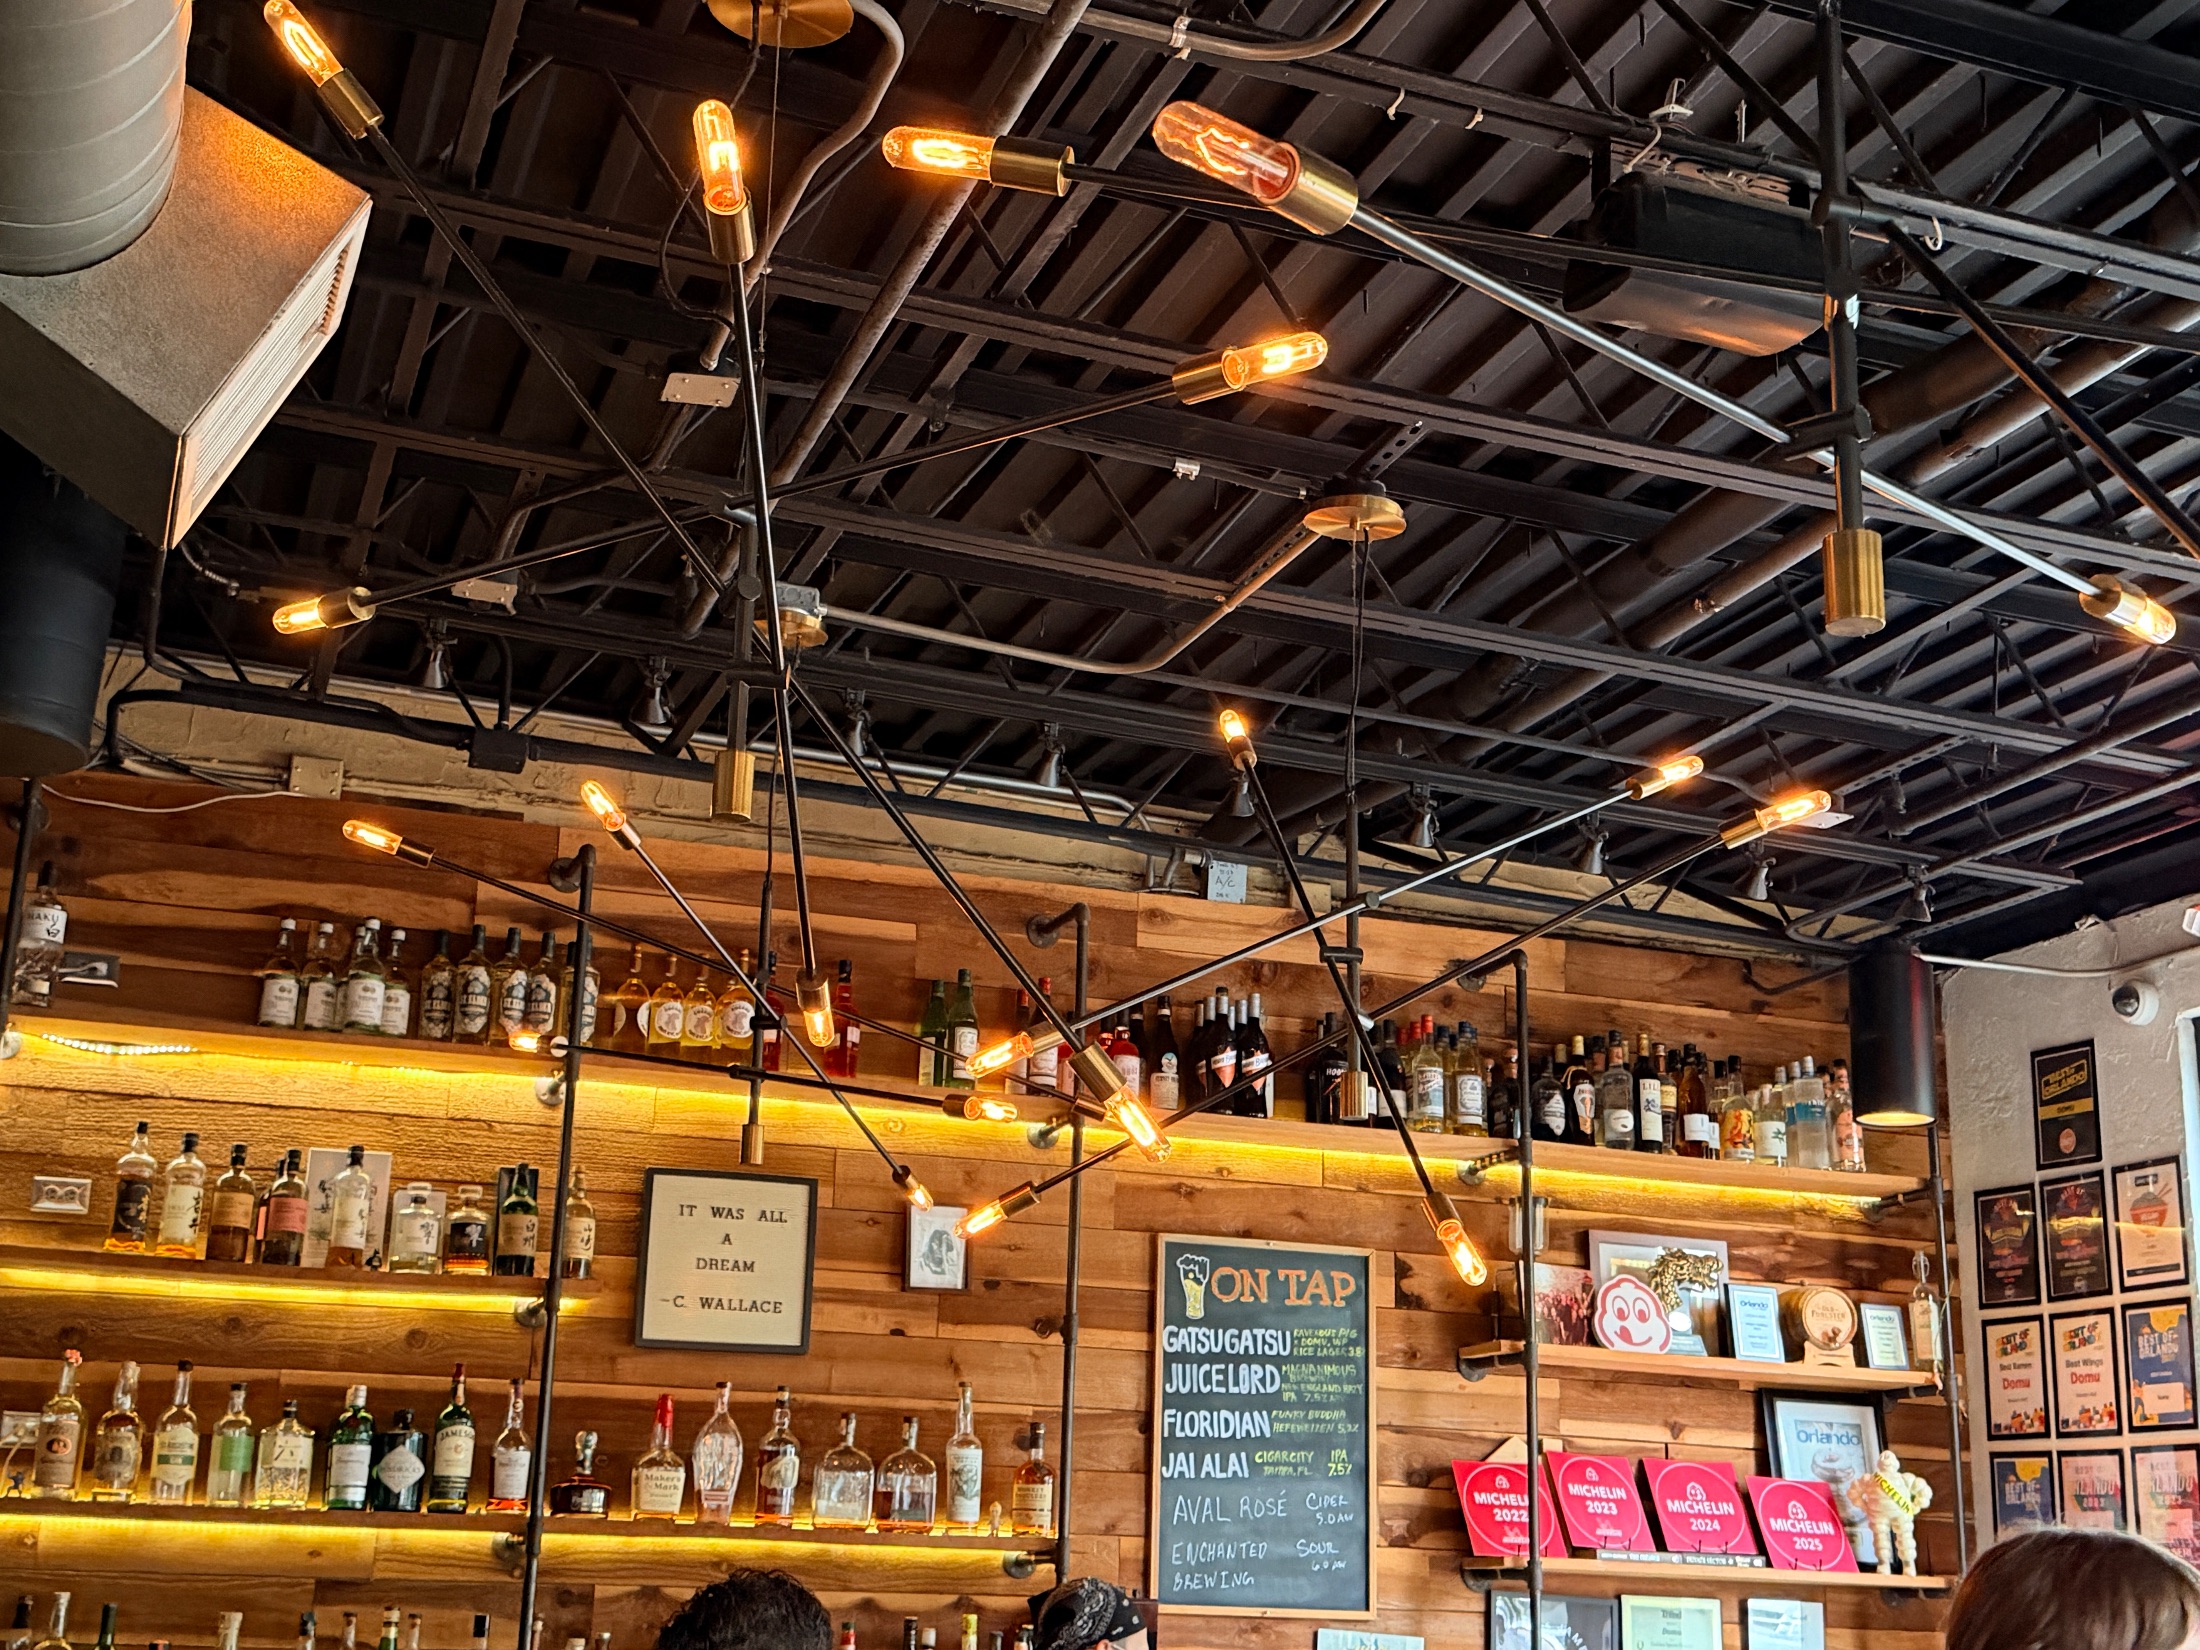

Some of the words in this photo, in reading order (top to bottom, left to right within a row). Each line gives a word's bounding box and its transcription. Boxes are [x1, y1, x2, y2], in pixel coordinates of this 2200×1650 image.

[1215, 875, 1235, 890] A/C
[679, 1204, 697, 1217] IT
[711, 1206, 745, 1220] WAS
[757, 1210, 788, 1223] ALL
[721, 1233, 733, 1246] A
[696, 1257, 756, 1273] DREAM
[1211, 1266, 1271, 1303] ON
[1277, 1269, 1356, 1307] TAP
[699, 1296, 783, 1314] WALLACE
[1338, 1328, 1358, 1338] PIG
[2138, 1333, 2161, 1346] BEST
[1293, 1347, 1315, 1356] RICE
[2066, 1360, 2081, 1368] Best
[2082, 1359, 2104, 1367] Wings
[2002, 1378, 2031, 1390] Domu
[2070, 1372, 2101, 1384] Domu
[1271, 1410, 1305, 1419] FUNKY
[1307, 1410, 1347, 1421] BUDDHA
[1163, 1409, 1271, 1439] FLORIDIAN
[1796, 1428, 1862, 1446] Orlando
[1331, 1449, 1348, 1462] IPA
[1161, 1452, 1196, 1479] JAI
[1200, 1451, 1250, 1479] ALAI
[654, 1483, 680, 1491] Mark
[1567, 1483, 1627, 1500] MICHELIN
[1173, 1495, 1231, 1525] AVAL
[1240, 1490, 1287, 1520] ROSÉ
[1306, 1492, 1349, 1510] CIDER
[1585, 1500, 1618, 1515] 2023
[1666, 1499, 1735, 1515] MICHELIN
[1493, 1508, 1529, 1522] 2022
[1689, 1518, 1721, 1532] 2024
[1769, 1518, 1835, 1535] MICHELIN
[1792, 1537, 1824, 1551] 2025
[1172, 1541, 1268, 1566] ENCHANTED
[1296, 1538, 1339, 1557] SOUR
[1173, 1571, 1255, 1592] BREWING
